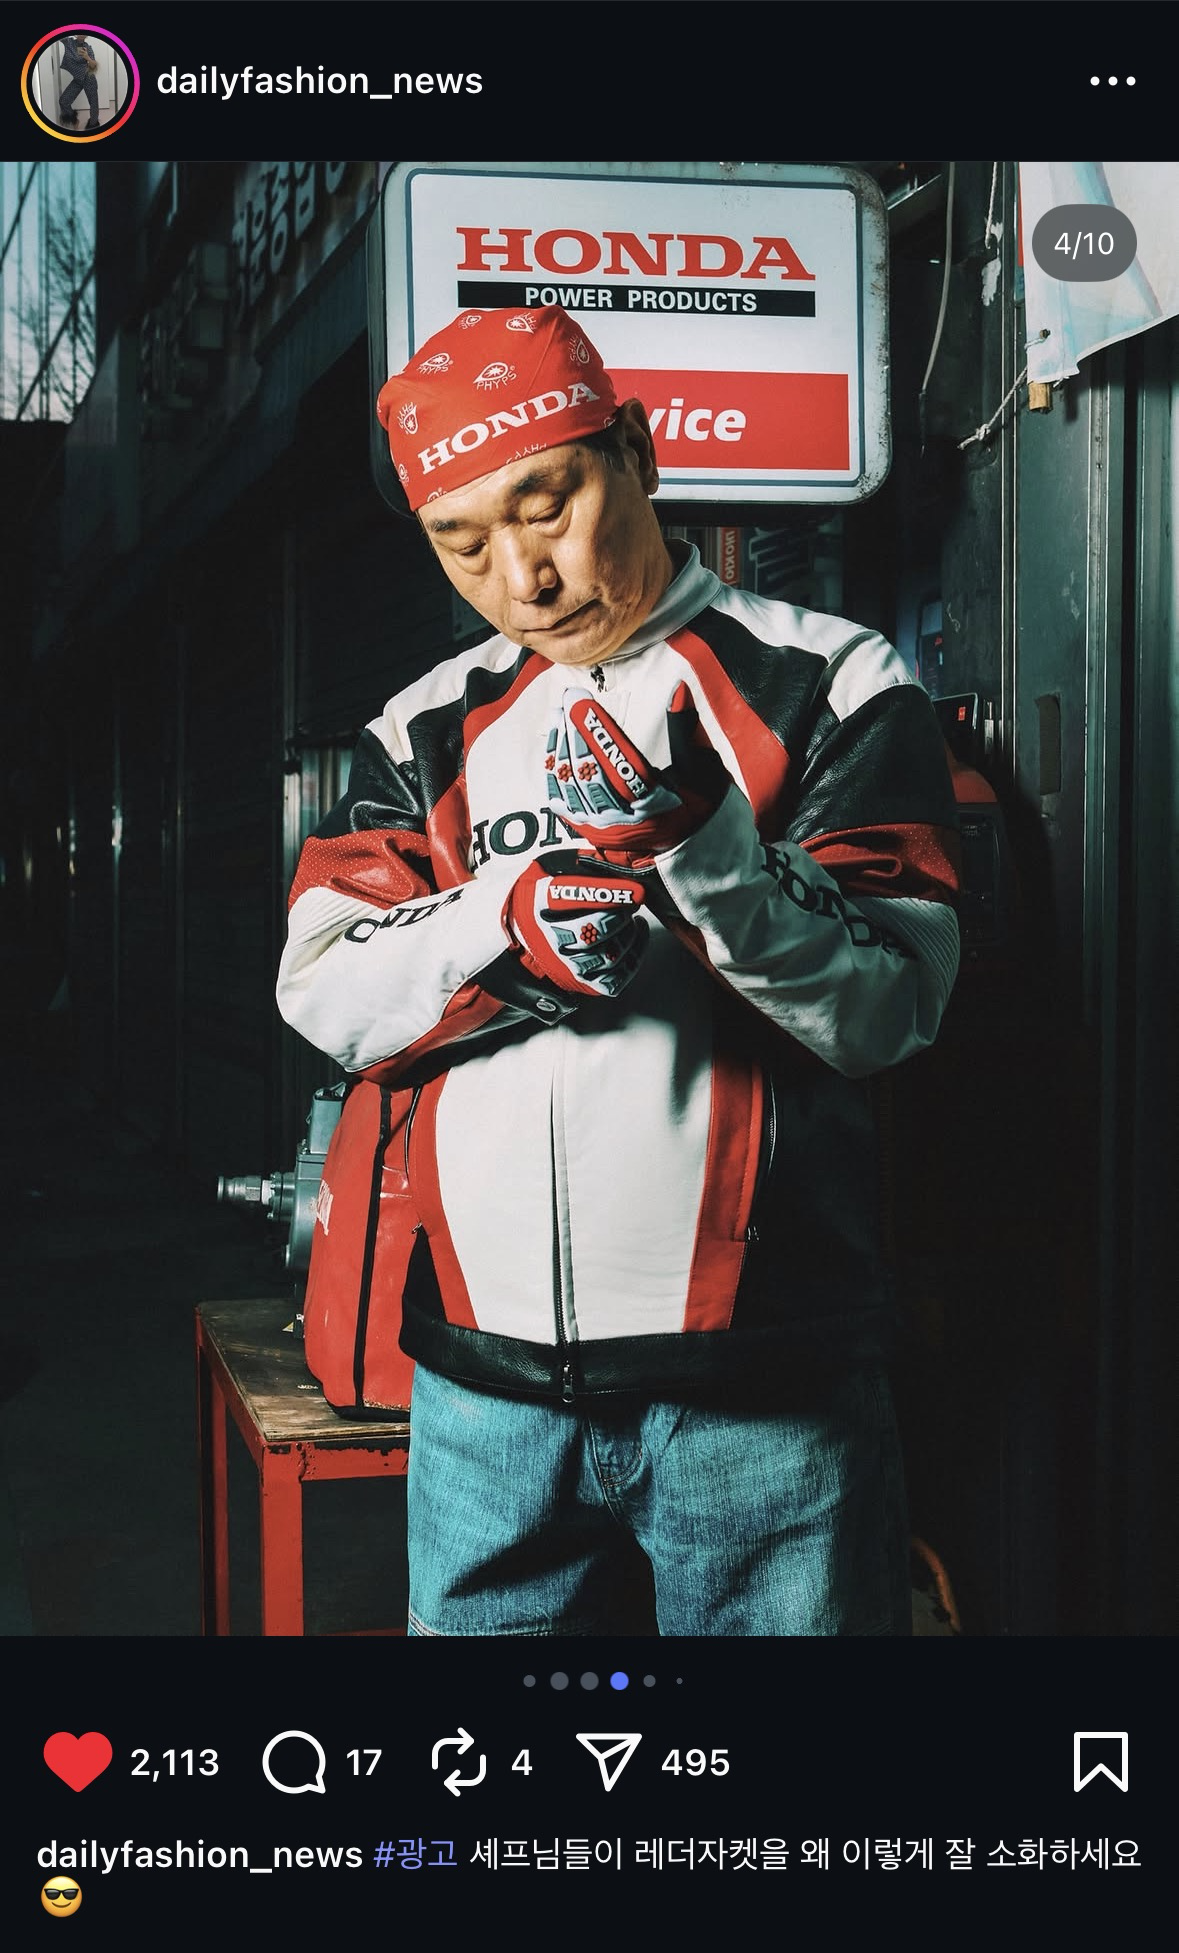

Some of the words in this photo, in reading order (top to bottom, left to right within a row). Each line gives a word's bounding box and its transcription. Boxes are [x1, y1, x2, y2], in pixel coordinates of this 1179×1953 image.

[456, 227, 816, 281] HONDA
[525, 287, 613, 309] POWER
[627, 290, 757, 313] PRODUCTS
[476, 371, 517, 391] PHYPS
[417, 382, 600, 475] HONDA
[583, 707, 649, 798] HONDA
[470, 806, 586, 873] HON
[344, 888, 465, 944] ONDA
[549, 885, 633, 904] HONDA
